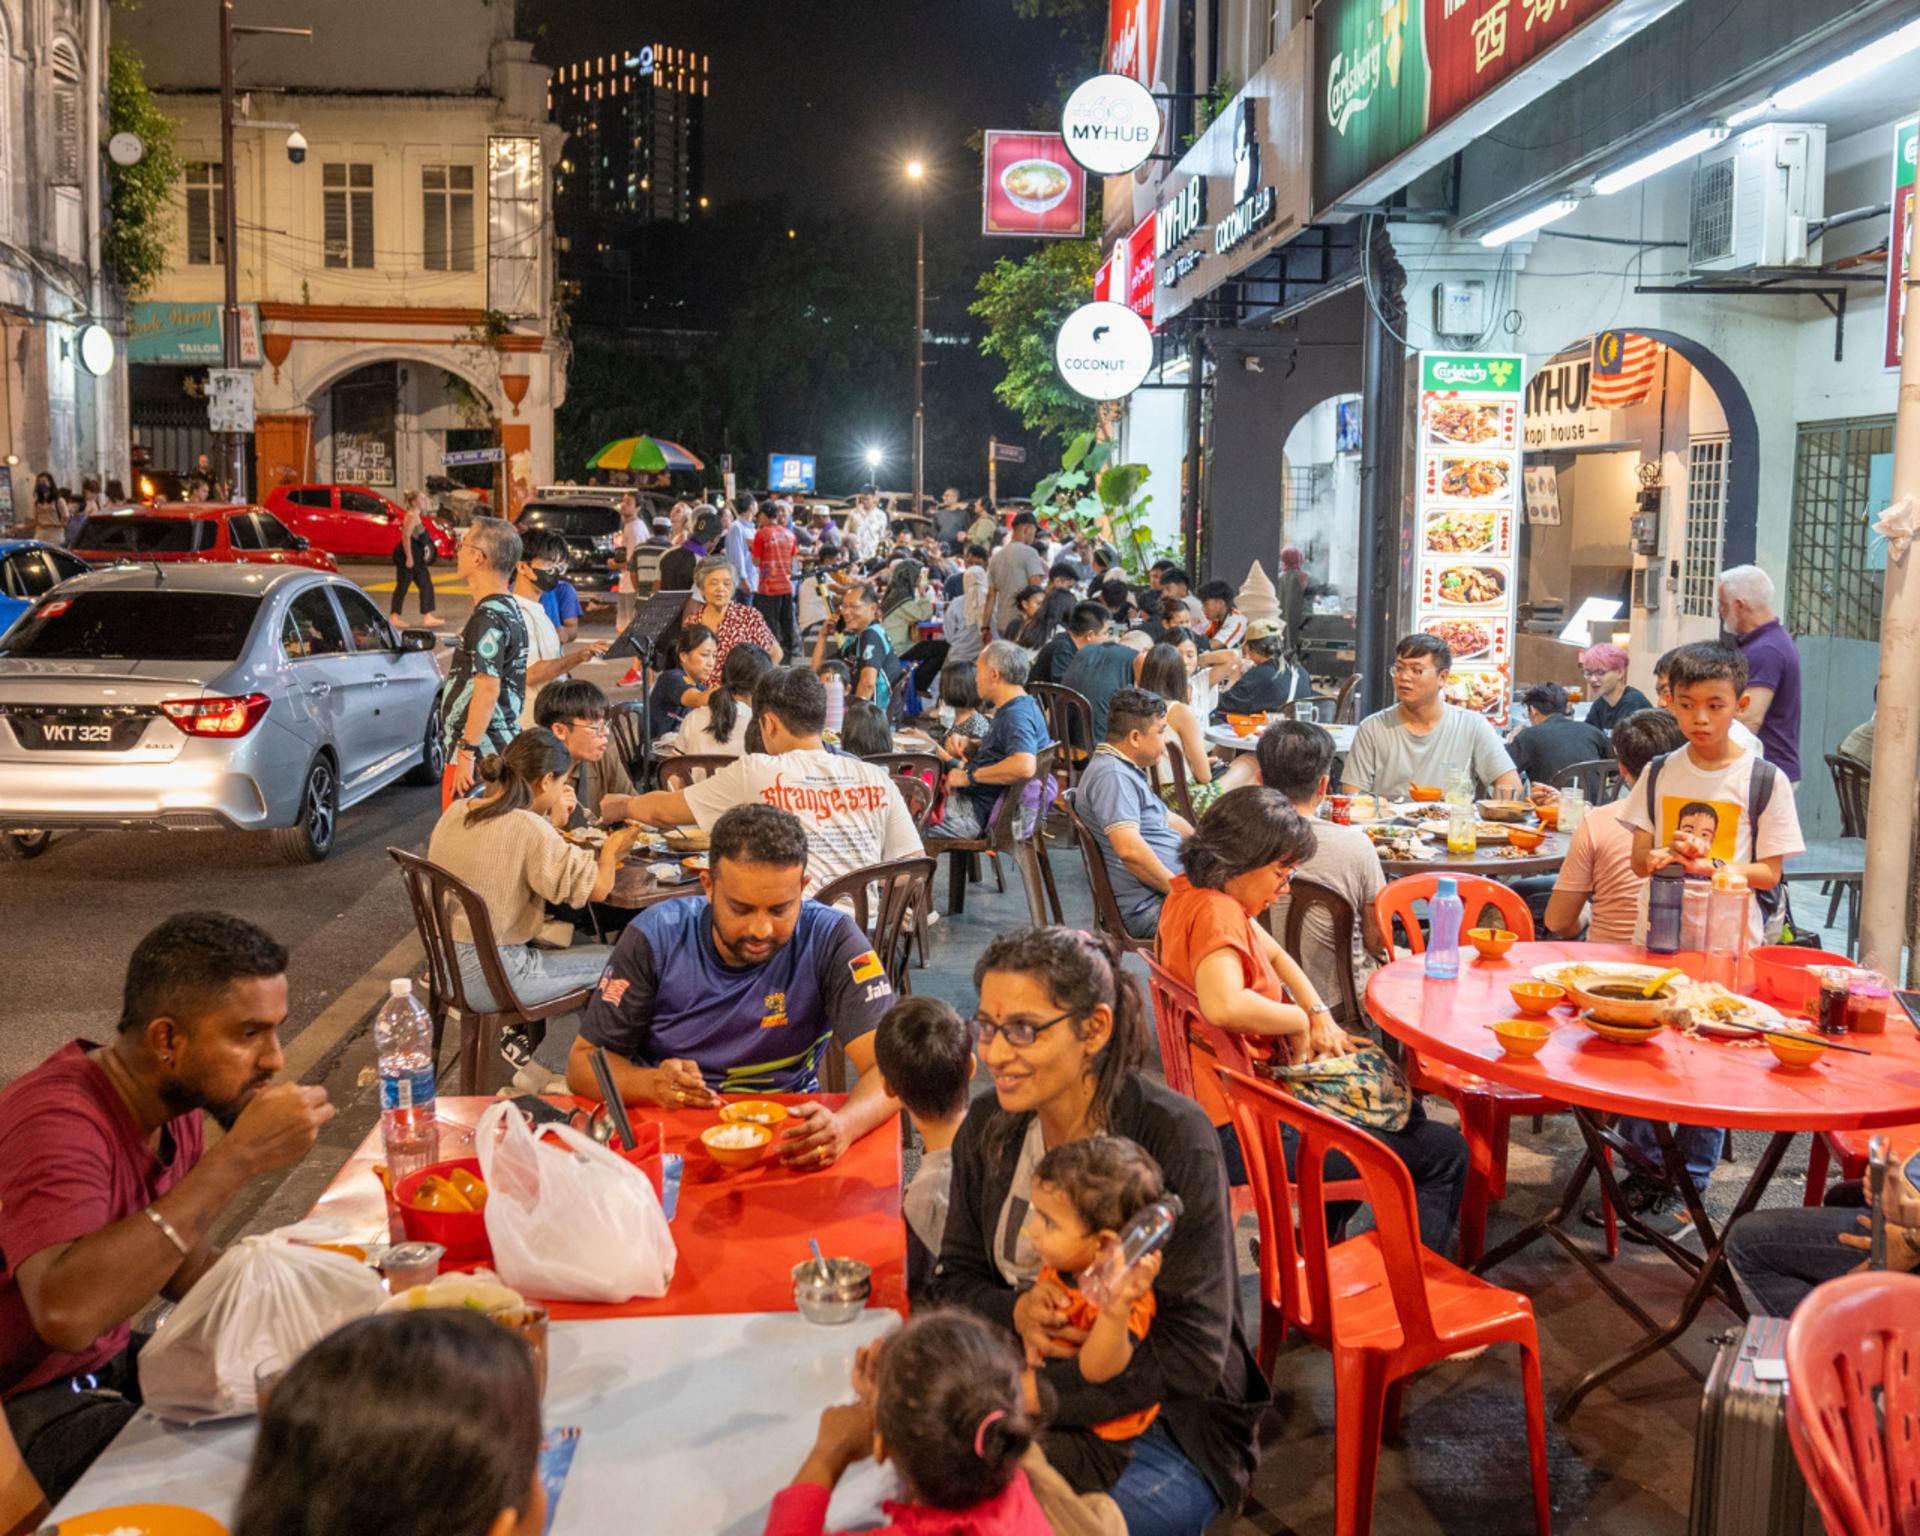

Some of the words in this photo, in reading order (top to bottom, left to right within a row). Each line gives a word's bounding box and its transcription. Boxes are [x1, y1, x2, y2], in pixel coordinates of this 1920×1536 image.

[1328, 38, 1381, 136] Carlsberg
[1072, 124, 1150, 142] MYHUB
[1156, 174, 1200, 259] MYHUB
[1215, 196, 1255, 254] COCONUT
[178, 343, 220, 353] TAILOR
[1064, 358, 1126, 370] COCONUT
[1432, 361, 1488, 384] Carlsberg
[1525, 362, 1591, 418] YHU
[1524, 425, 1546, 447] kopi
[1550, 423, 1585, 443] house
[43, 725, 77, 741] VKT
[78, 726, 112, 742] 329
[759, 772, 848, 827] strange
